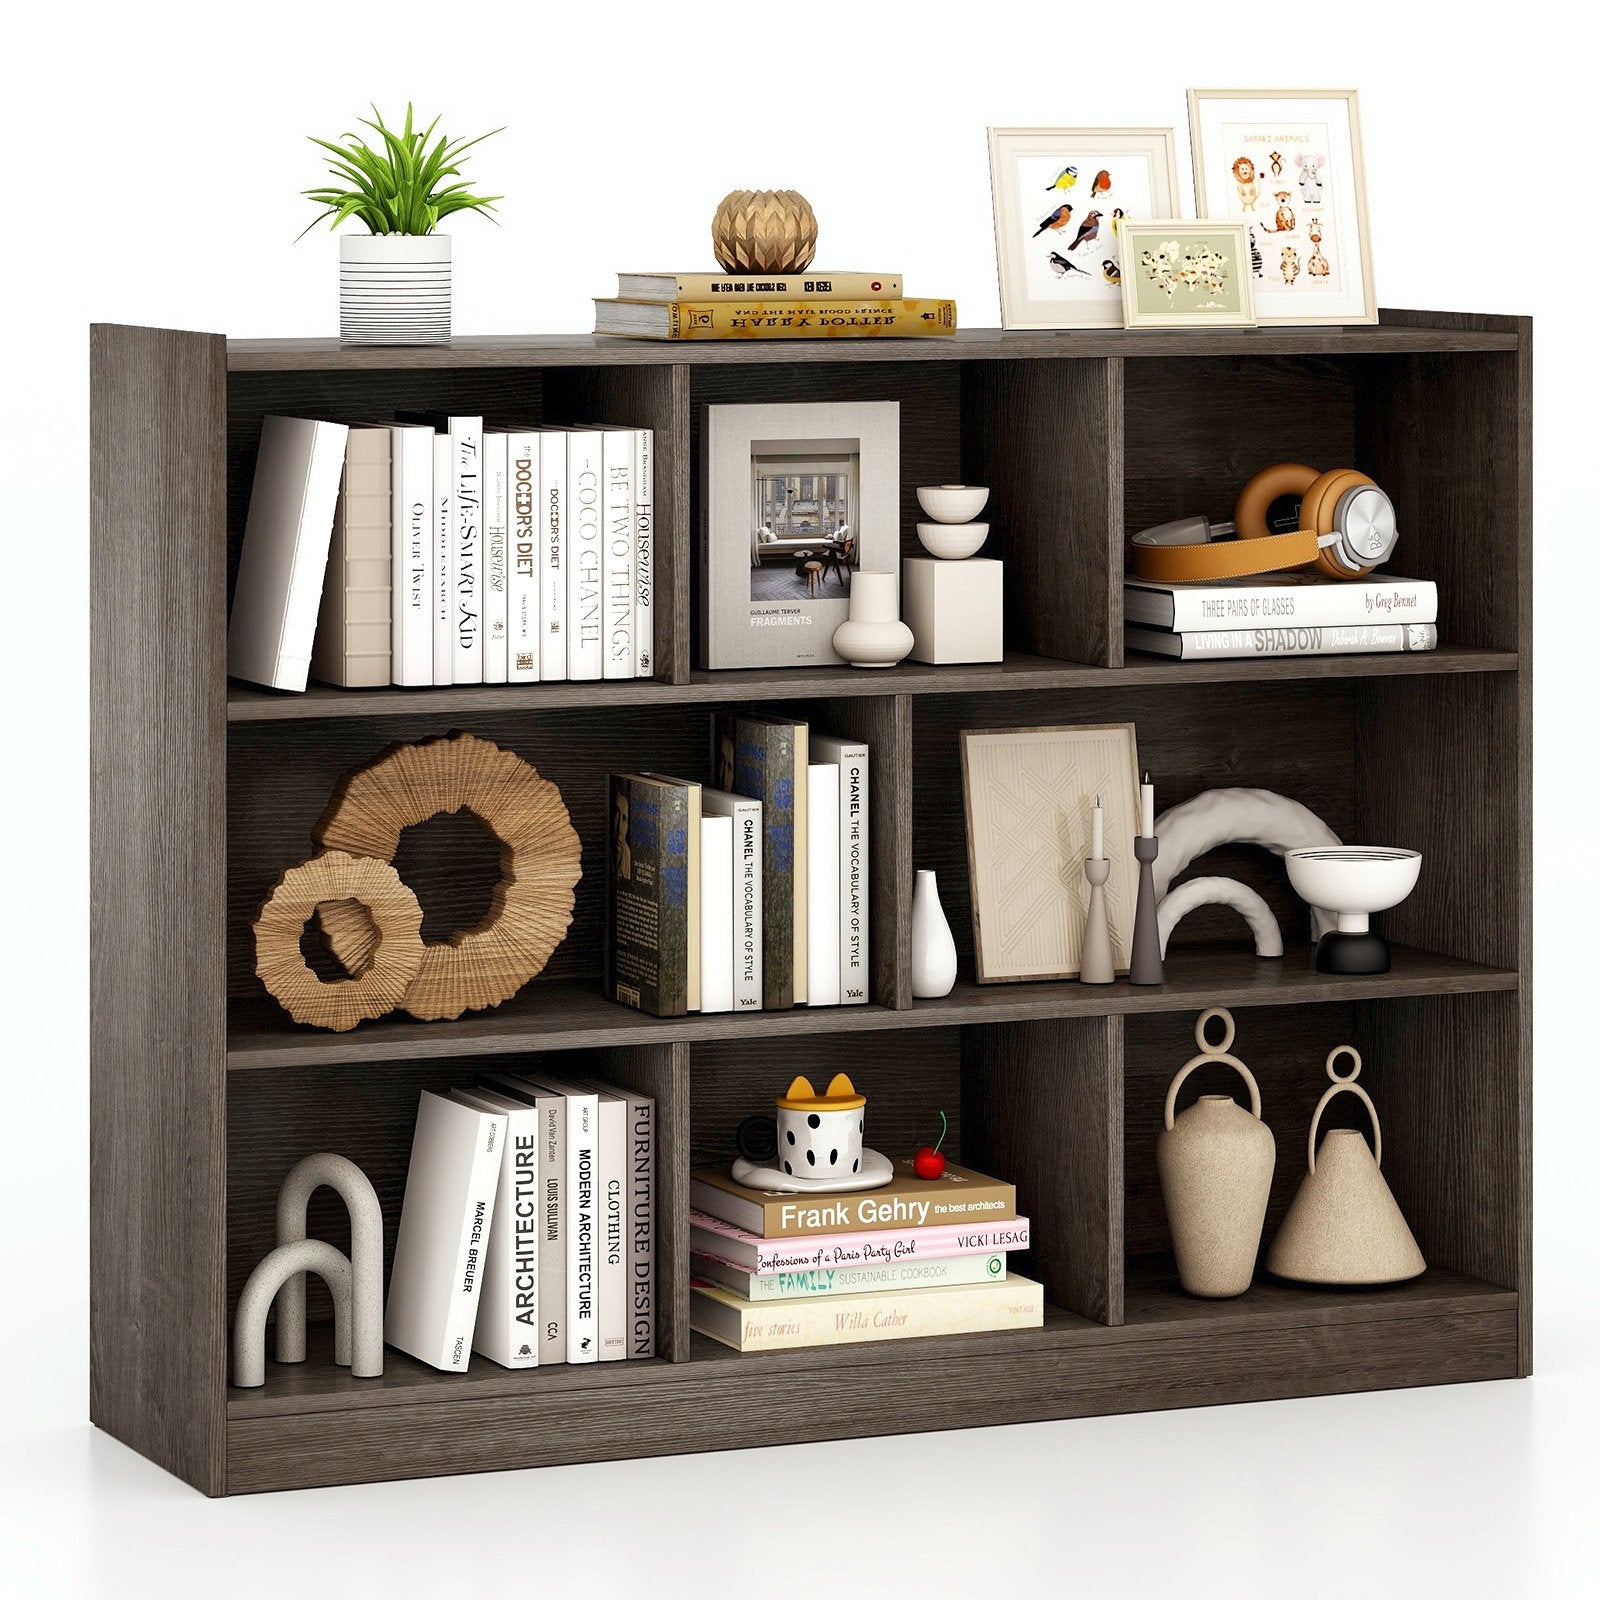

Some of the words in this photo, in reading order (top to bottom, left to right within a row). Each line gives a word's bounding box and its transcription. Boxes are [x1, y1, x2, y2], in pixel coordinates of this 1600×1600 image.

[610, 466, 629, 492] BE
[411, 503, 425, 558] OLIVER
[611, 498, 630, 557] TWO
[440, 497, 449, 621] MIDDLEMARCH
[489, 526, 505, 592] Housewise
[517, 543, 534, 577] DIET
[550, 546, 560, 570] DIET
[636, 504, 652, 607] Housewise
[411, 563, 425, 610] TWIST
[580, 550, 599, 649] CHANEL
[1365, 593, 1374, 613] by
[1375, 592, 1392, 613] Greg
[750, 615, 812, 627] FRAGMENTS
[1202, 600, 1225, 617] THREE
[1227, 599, 1249, 616] PAIRS
[1250, 598, 1260, 616] OF
[1262, 597, 1295, 616] GLASSES
[1194, 633, 1230, 650] LIVING
[1231, 632, 1241, 649] IN
[1244, 631, 1254, 648] A
[1254, 628, 1323, 652] SHADOW
[850, 767, 860, 818] CHANEL
[743, 819, 754, 860] CHANEL
[850, 818, 860, 840] THE
[744, 860, 754, 879] THE
[850, 843, 860, 915] VOCABULARY
[744, 880, 754, 937] VOCABULARY
[850, 917, 860, 933] OF
[744, 938, 754, 953] OF
[850, 935, 860, 968] STYLE
[744, 954, 754, 981] STYLE
[740, 998, 758, 1006] Yale
[846, 989, 864, 998] Yale
[548, 1109, 557, 1127] David
[549, 1127, 557, 1140] Van
[549, 1140, 557, 1162] Zanten
[547, 1178, 558, 1201] LOUIS
[579, 1149, 592, 1209] MODERN
[634, 1104, 650, 1254] FURNITURE
[470, 1201, 486, 1245] MARCEL
[547, 1203, 558, 1241] SULLIVAN
[608, 1180, 620, 1265] CLOTHING
[781, 1199, 850, 1229] Frank
[858, 1197, 930, 1225] Gehry
[934, 1205, 948, 1214] the
[949, 1203, 966, 1213] best
[967, 1200, 1006, 1211] architects
[515, 1135, 534, 1326] ARCHITECTURE
[958, 1234, 989, 1248] VICKI
[579, 1213, 592, 1320] ARCHITECTURE
[812, 1249, 823, 1267] of
[824, 1254, 831, 1262] a
[833, 1246, 861, 1264] Paris
[863, 1244, 892, 1263] Party
[894, 1239, 916, 1258] Girl
[462, 1247, 478, 1293] BREUER
[760, 1280, 775, 1292] THE
[778, 1270, 835, 1293] FAMILY
[839, 1269, 898, 1285] SUSTAINABLE
[900, 1266, 948, 1280] COOKBOOK
[634, 1261, 650, 1355] DESIGN
[743, 1320, 763, 1344] five
[767, 1317, 801, 1336] stories
[835, 1311, 868, 1330] Willa
[873, 1309, 908, 1328] Cather
[1008, 1305, 1035, 1314] VINTAGE
